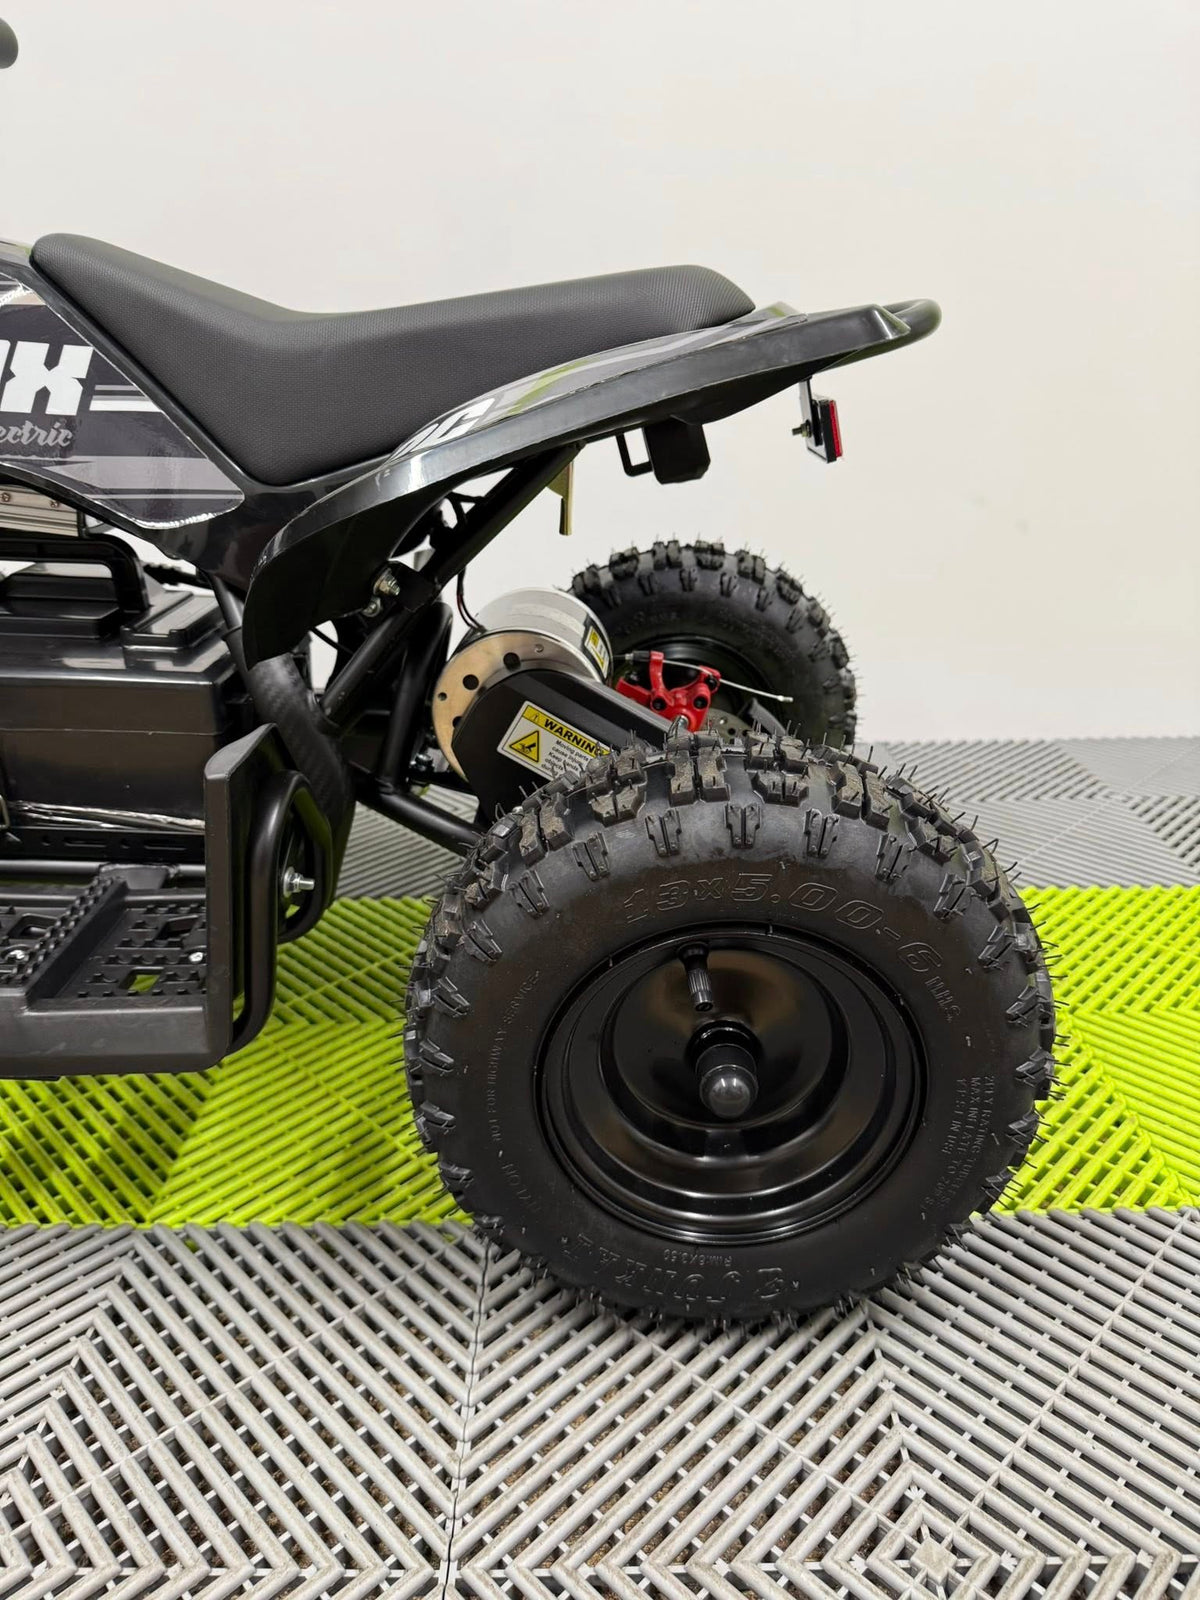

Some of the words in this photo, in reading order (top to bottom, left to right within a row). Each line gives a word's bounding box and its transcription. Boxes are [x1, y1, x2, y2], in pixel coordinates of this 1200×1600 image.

[0, 339, 94, 416] X
[556, 740, 575, 755] Moving
[549, 751, 562, 763] Keep
[568, 754, 584, 766] injur
[624, 873, 943, 972] 13x5.00-6
